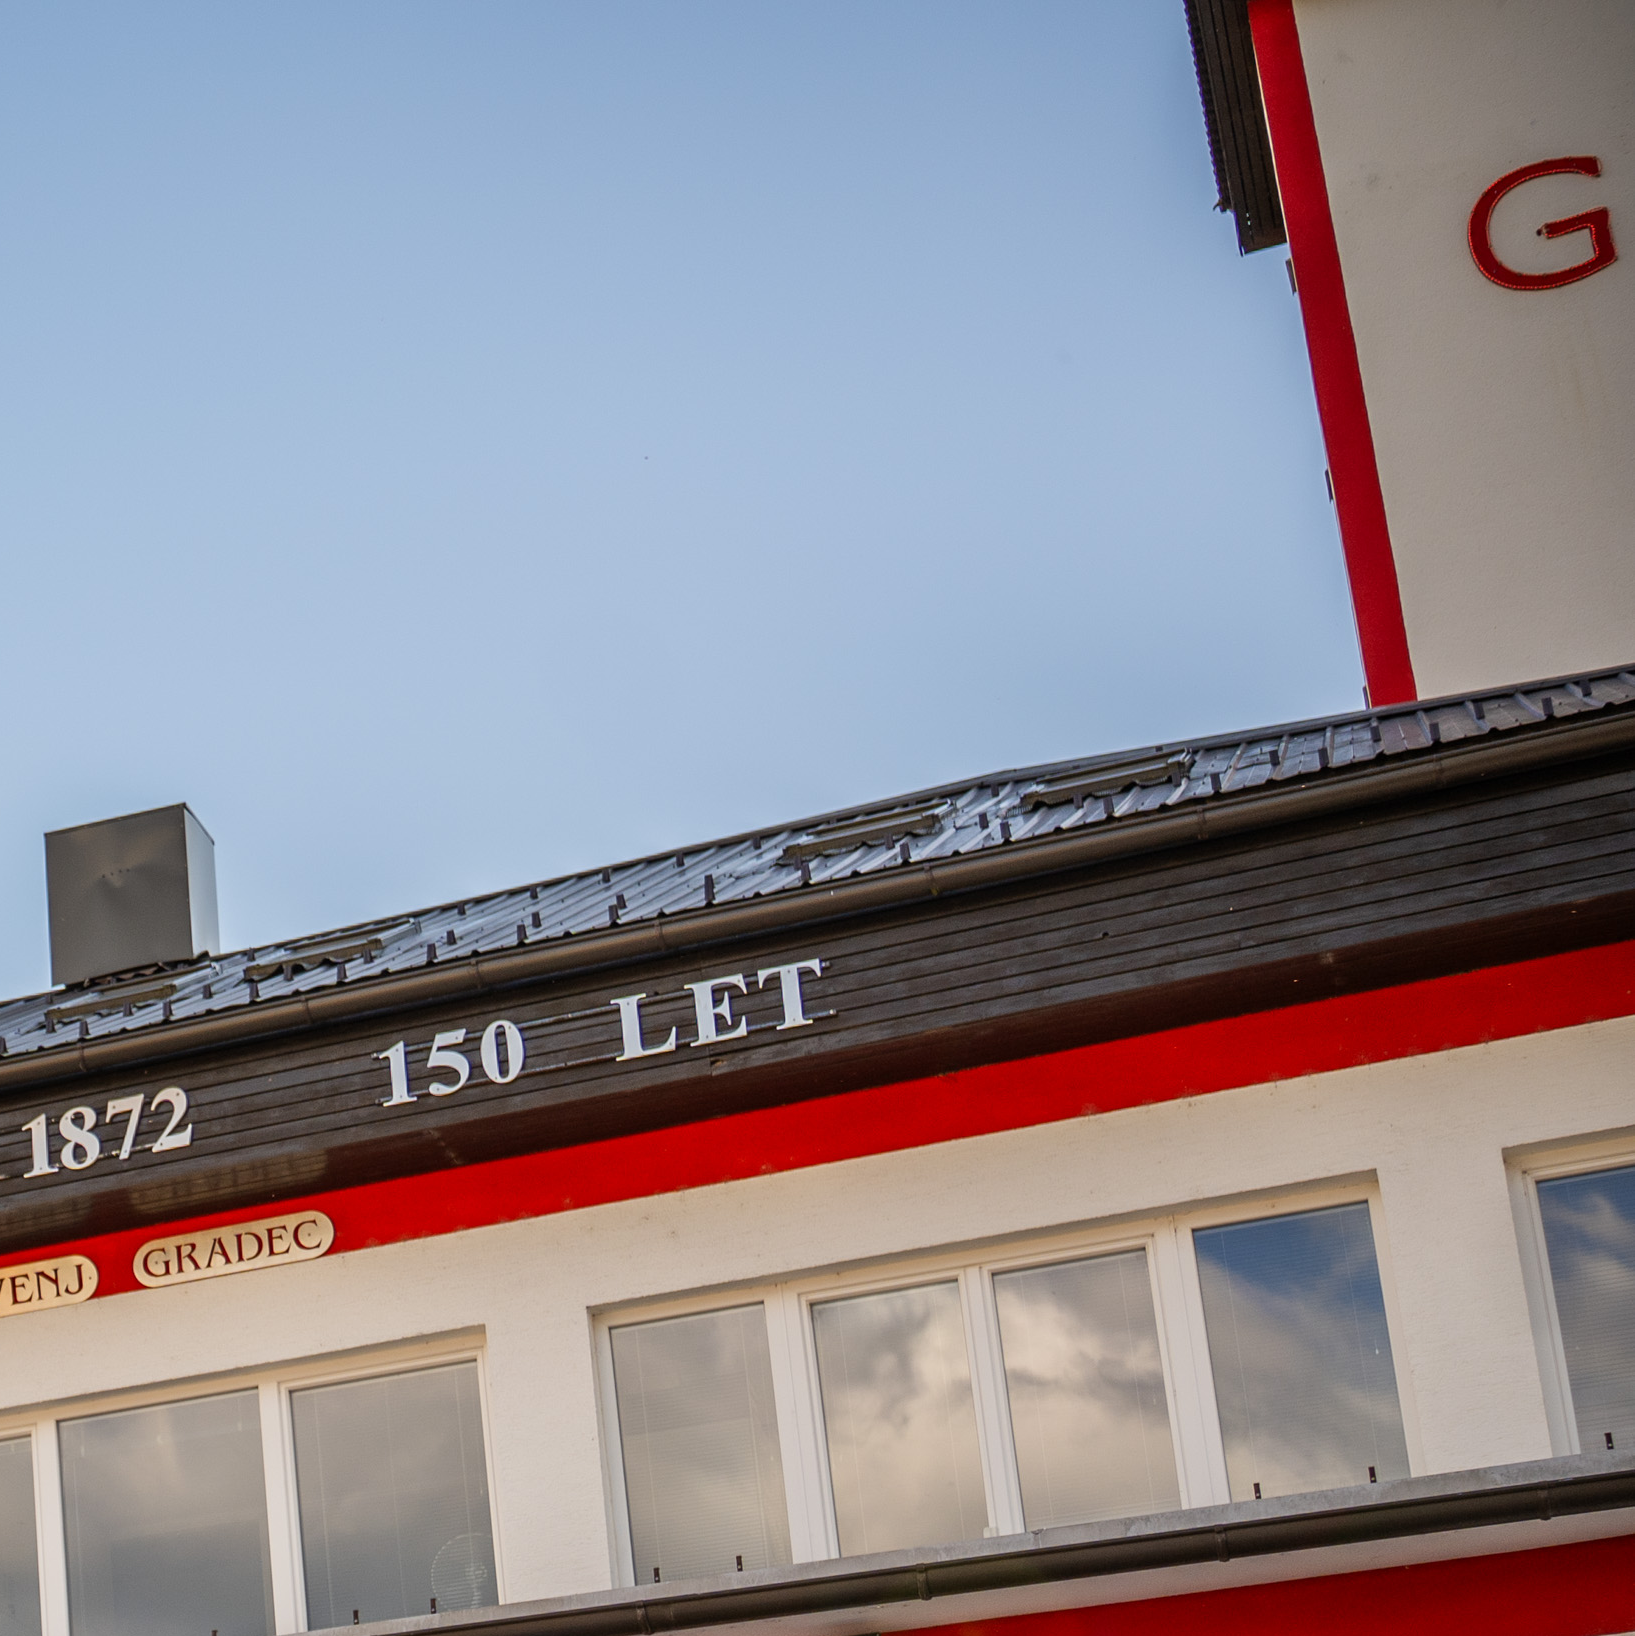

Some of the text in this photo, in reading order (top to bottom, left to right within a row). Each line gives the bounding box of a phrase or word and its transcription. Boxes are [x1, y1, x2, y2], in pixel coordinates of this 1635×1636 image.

[1468, 155, 1617, 291] G
[22, 1086, 193, 1178] 1872
[379, 1020, 526, 1107] 150
[610, 958, 822, 1062] LET
[141, 1218, 324, 1278] GRADEC
